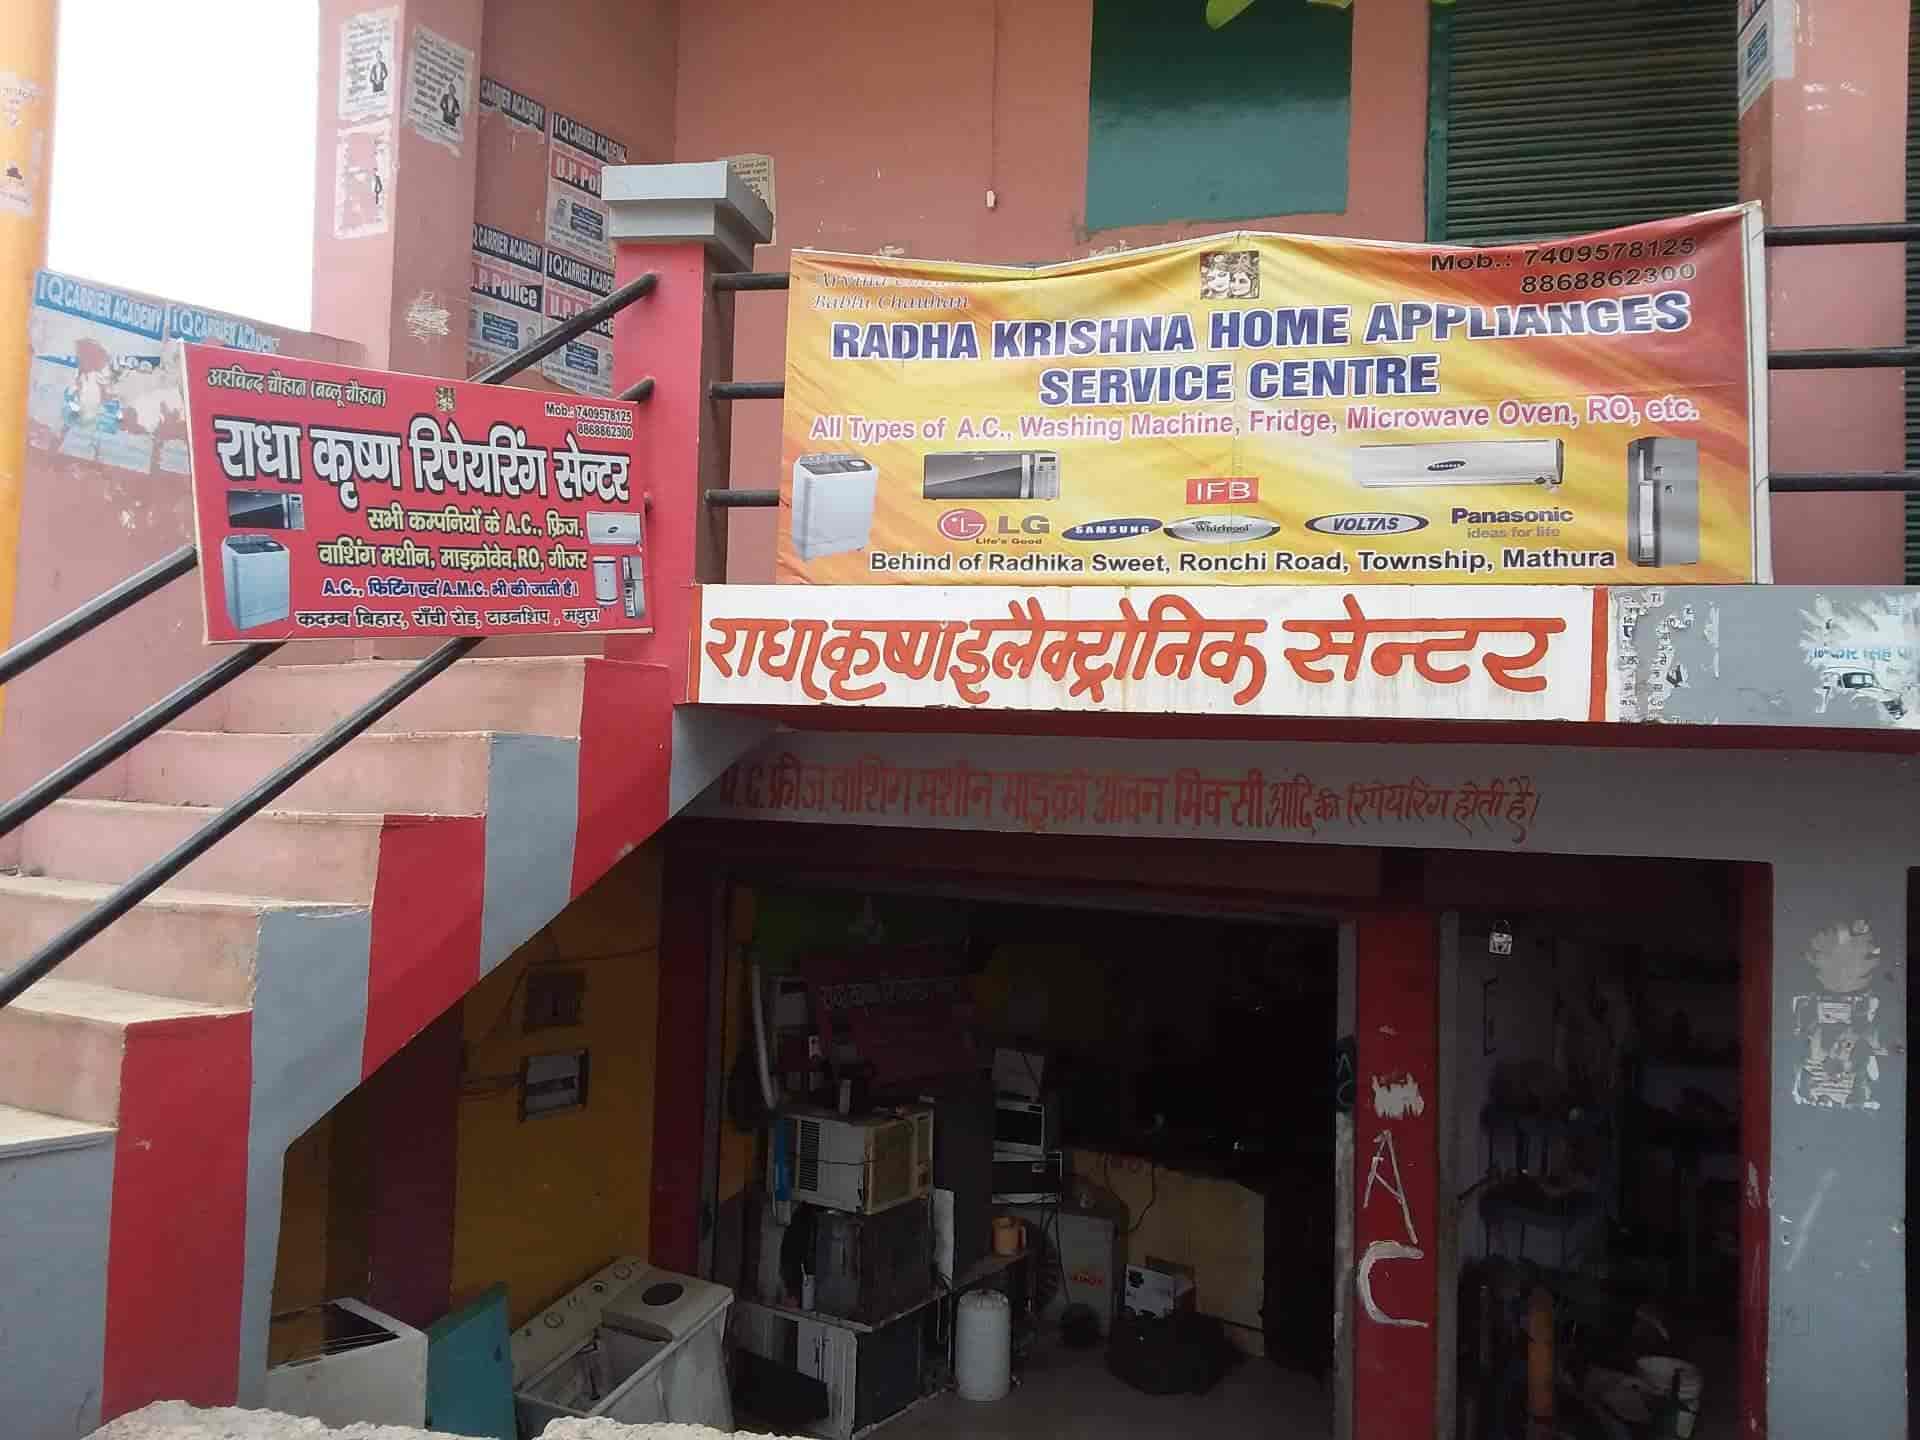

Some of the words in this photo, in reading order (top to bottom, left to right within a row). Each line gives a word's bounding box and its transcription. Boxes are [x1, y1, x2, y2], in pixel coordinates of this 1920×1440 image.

[1524, 238, 1696, 266] 7409578125
[491, 269, 538, 308] Police
[1521, 264, 1696, 293] 8868862300
[834, 323, 978, 359] RADHA
[994, 315, 1193, 358] KRISHNA
[1211, 308, 1349, 349] HOME
[1366, 292, 1690, 343] APPLIANCES
[207, 364, 265, 393] अरविन्द
[267, 370, 306, 396] चौहान
[1041, 364, 1232, 405] SERVICE
[1250, 357, 1438, 398] CENTRE
[576, 405, 633, 423] 7409578125
[812, 416, 843, 438] All
[849, 416, 914, 444] Types
[923, 416, 946, 438] of
[957, 417, 1012, 441] A.C.,
[1021, 414, 1122, 442] Washing
[1131, 413, 1240, 437] Machine,
[1250, 409, 1337, 438] Fridge,
[1347, 406, 1489, 429] Microwave
[1499, 401, 1579, 427] Oven,
[1588, 397, 1639, 424] RO,
[1647, 398, 1698, 420] etc.
[214, 417, 302, 481] राधा
[309, 427, 401, 509] कृष्ण
[409, 414, 547, 497] रिपेयरिंग
[553, 431, 630, 501] सेन्टर
[1196, 481, 1250, 501] IFB
[367, 502, 405, 531] सभी
[408, 505, 482, 534] कम्पनियों
[483, 508, 500, 535] के
[999, 515, 1050, 535] LG
[1075, 524, 1151, 536] SAMSUNG
[1194, 521, 1251, 536] Whirlpool
[1333, 517, 1401, 531] VOLTAS
[1451, 506, 1574, 524] Panasonic
[1467, 527, 1508, 539] ideas
[1512, 526, 1533, 538] for
[1536, 526, 1561, 538] life
[317, 535, 376, 565] वाशिंग
[381, 538, 436, 569] मशीन,
[547, 543, 587, 569] गीजर
[1011, 537, 1043, 545] Good
[871, 552, 952, 572] Behind
[958, 552, 982, 572] of
[988, 552, 1084, 572] Radhika
[1092, 554, 1171, 576] Sweet,
[1179, 551, 1268, 573] Ronchi
[1276, 550, 1349, 575] Road,
[1357, 550, 1493, 574] Township,
[1503, 548, 1615, 570] Mathura
[442, 581, 489, 597] A.M.C.
[491, 577, 507, 597] भी
[511, 577, 528, 597] की
[531, 578, 560, 597] जाती
[296, 611, 350, 628] कदम्ब
[563, 608, 600, 628] मथुरा
[1283, 593, 1567, 693] सेन्टर
